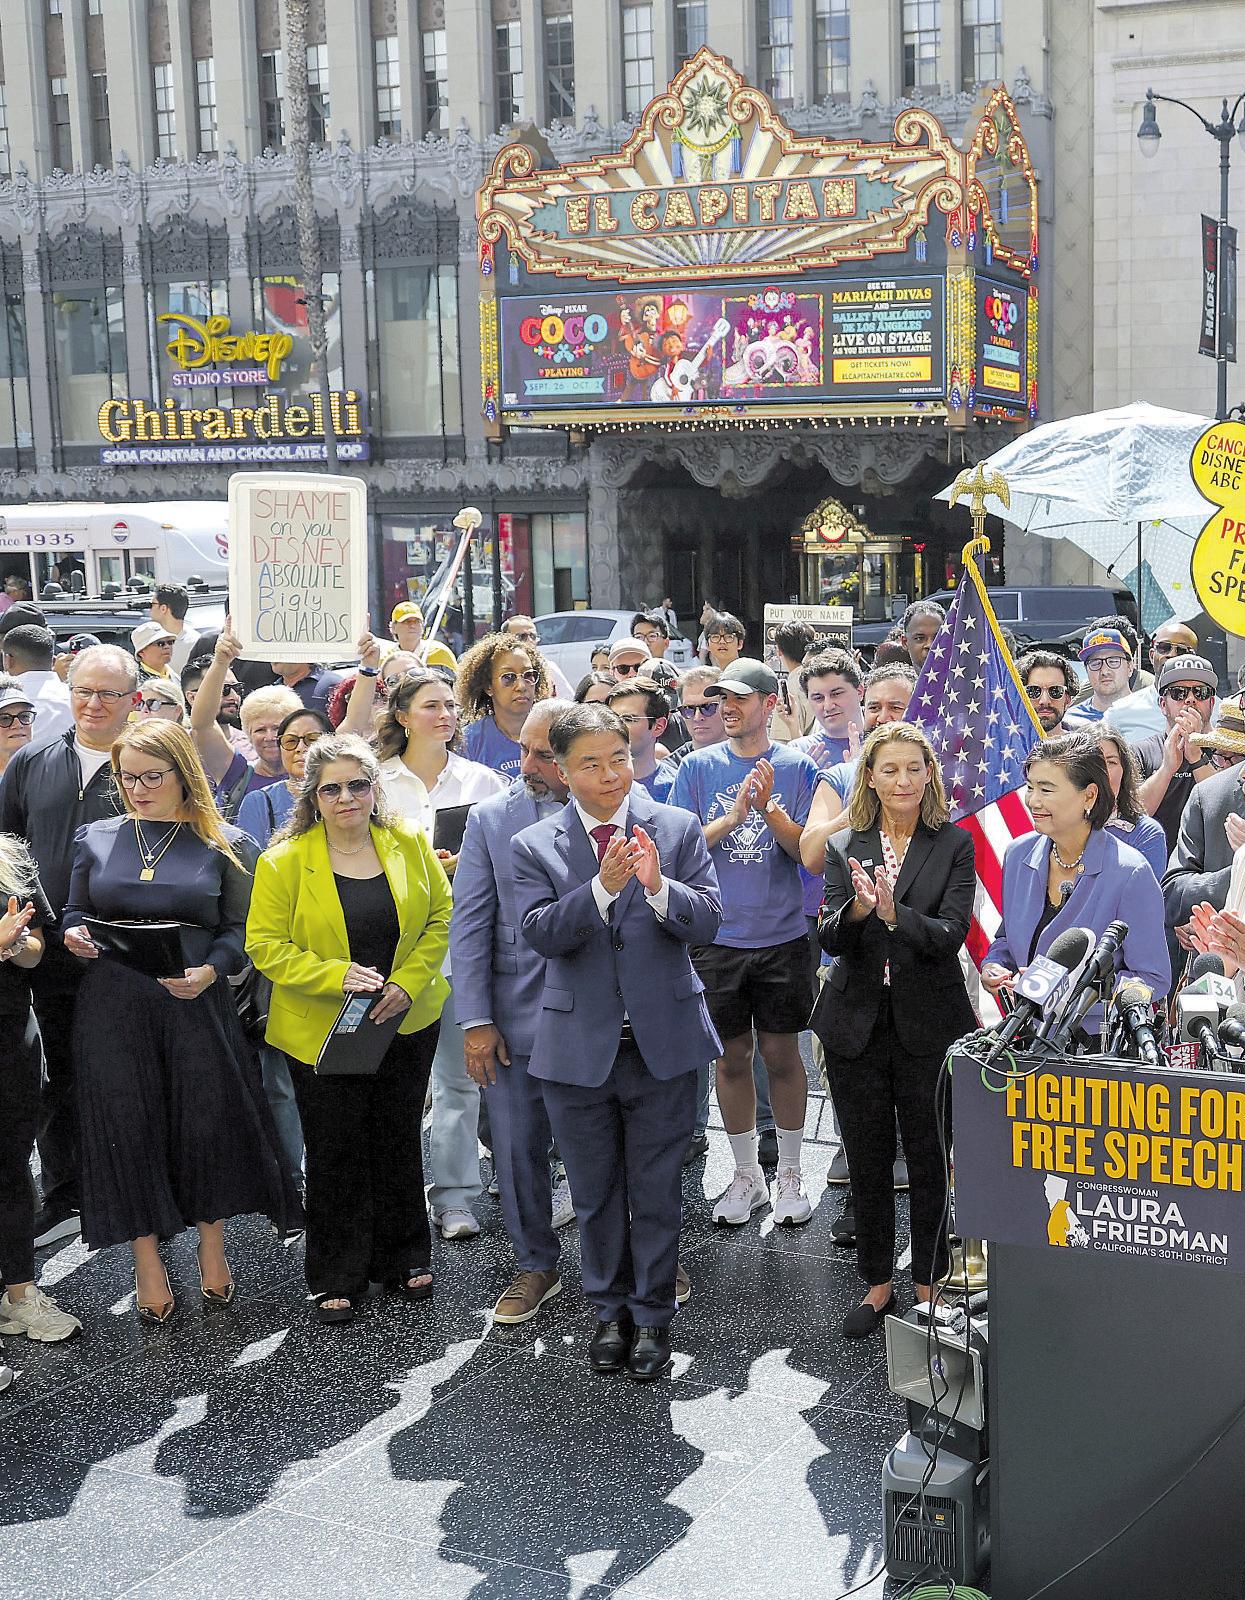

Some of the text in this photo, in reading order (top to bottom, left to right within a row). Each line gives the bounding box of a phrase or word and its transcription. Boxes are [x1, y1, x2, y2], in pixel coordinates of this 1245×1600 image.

[565, 178, 857, 233] EL CAPITAN
[881, 281, 896, 289] THE
[832, 288, 932, 303] MARIACHI DIVAS
[564, 304, 588, 313] PIXAR
[832, 312, 871, 323] BALLET
[520, 314, 608, 346] COCO
[842, 323, 855, 333] DE
[857, 322, 875, 332] LOS
[832, 331, 932, 347] LIVE ON STAGE
[832, 347, 843, 355] AS
[844, 346, 857, 354] YOU
[859, 346, 881, 354] ENTER
[882, 345, 896, 353] THE
[544, 367, 584, 378] PLAYING
[891, 360, 911, 368] NOW!
[172, 370, 268, 386] STUDIO STORE
[98, 390, 362, 442] Ghirardelli
[102, 449, 139, 463] SODA
[140, 448, 207, 463] FOUNTAIN
[207, 447, 236, 461] AND
[237, 445, 320, 460] CHOCOLATE
[1210, 471, 1242, 490] ABC
[255, 489, 347, 521] SHAME
[25, 533, 75, 546] 1935
[270, 521, 332, 544] on you
[253, 535, 350, 566] DISNEY
[258, 562, 345, 589] ABSOLUTE
[258, 586, 322, 612] Bigly
[769, 608, 845, 620] PUT YOUR NAME
[256, 611, 349, 642] COWARDS
[827, 632, 849, 641] STARS
[1021, 968, 1055, 999] 5
[1213, 980, 1235, 1001] 34
[1005, 1070, 1171, 1133] FIGHTING
[1011, 1121, 1243, 1192] FREE SPEECH
[1076, 1181, 1159, 1198] CONGRESSWOMAN
[1076, 1191, 1186, 1227] LAURA
[1092, 1219, 1228, 1254] FRIEDMAN
[1093, 1241, 1228, 1266] CALIFORNIA'S 30TH DISTRICT
